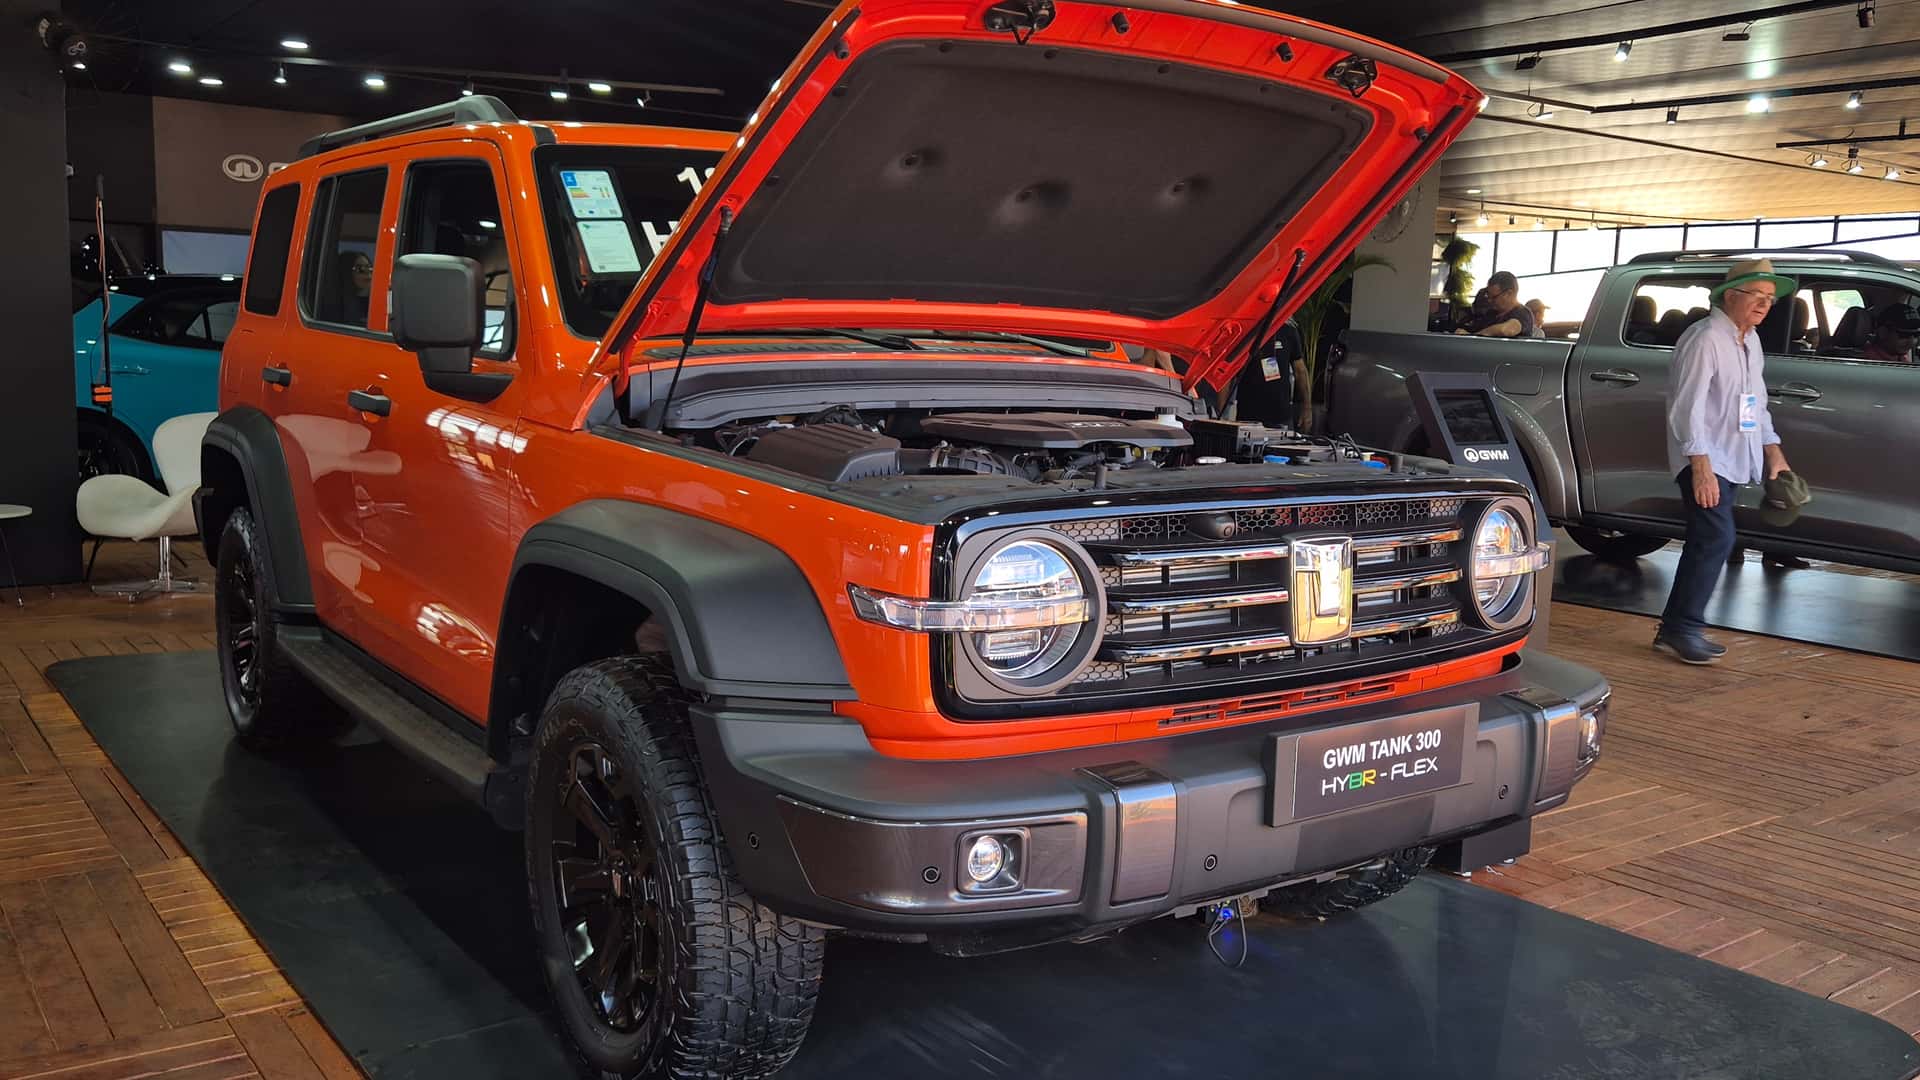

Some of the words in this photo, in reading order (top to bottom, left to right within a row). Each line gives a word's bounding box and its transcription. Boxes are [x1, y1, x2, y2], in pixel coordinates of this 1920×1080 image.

[1479, 449, 1510, 460] GWM
[1323, 743, 1366, 769] GWM
[1369, 734, 1413, 760] TANK
[1415, 729, 1442, 751] 300
